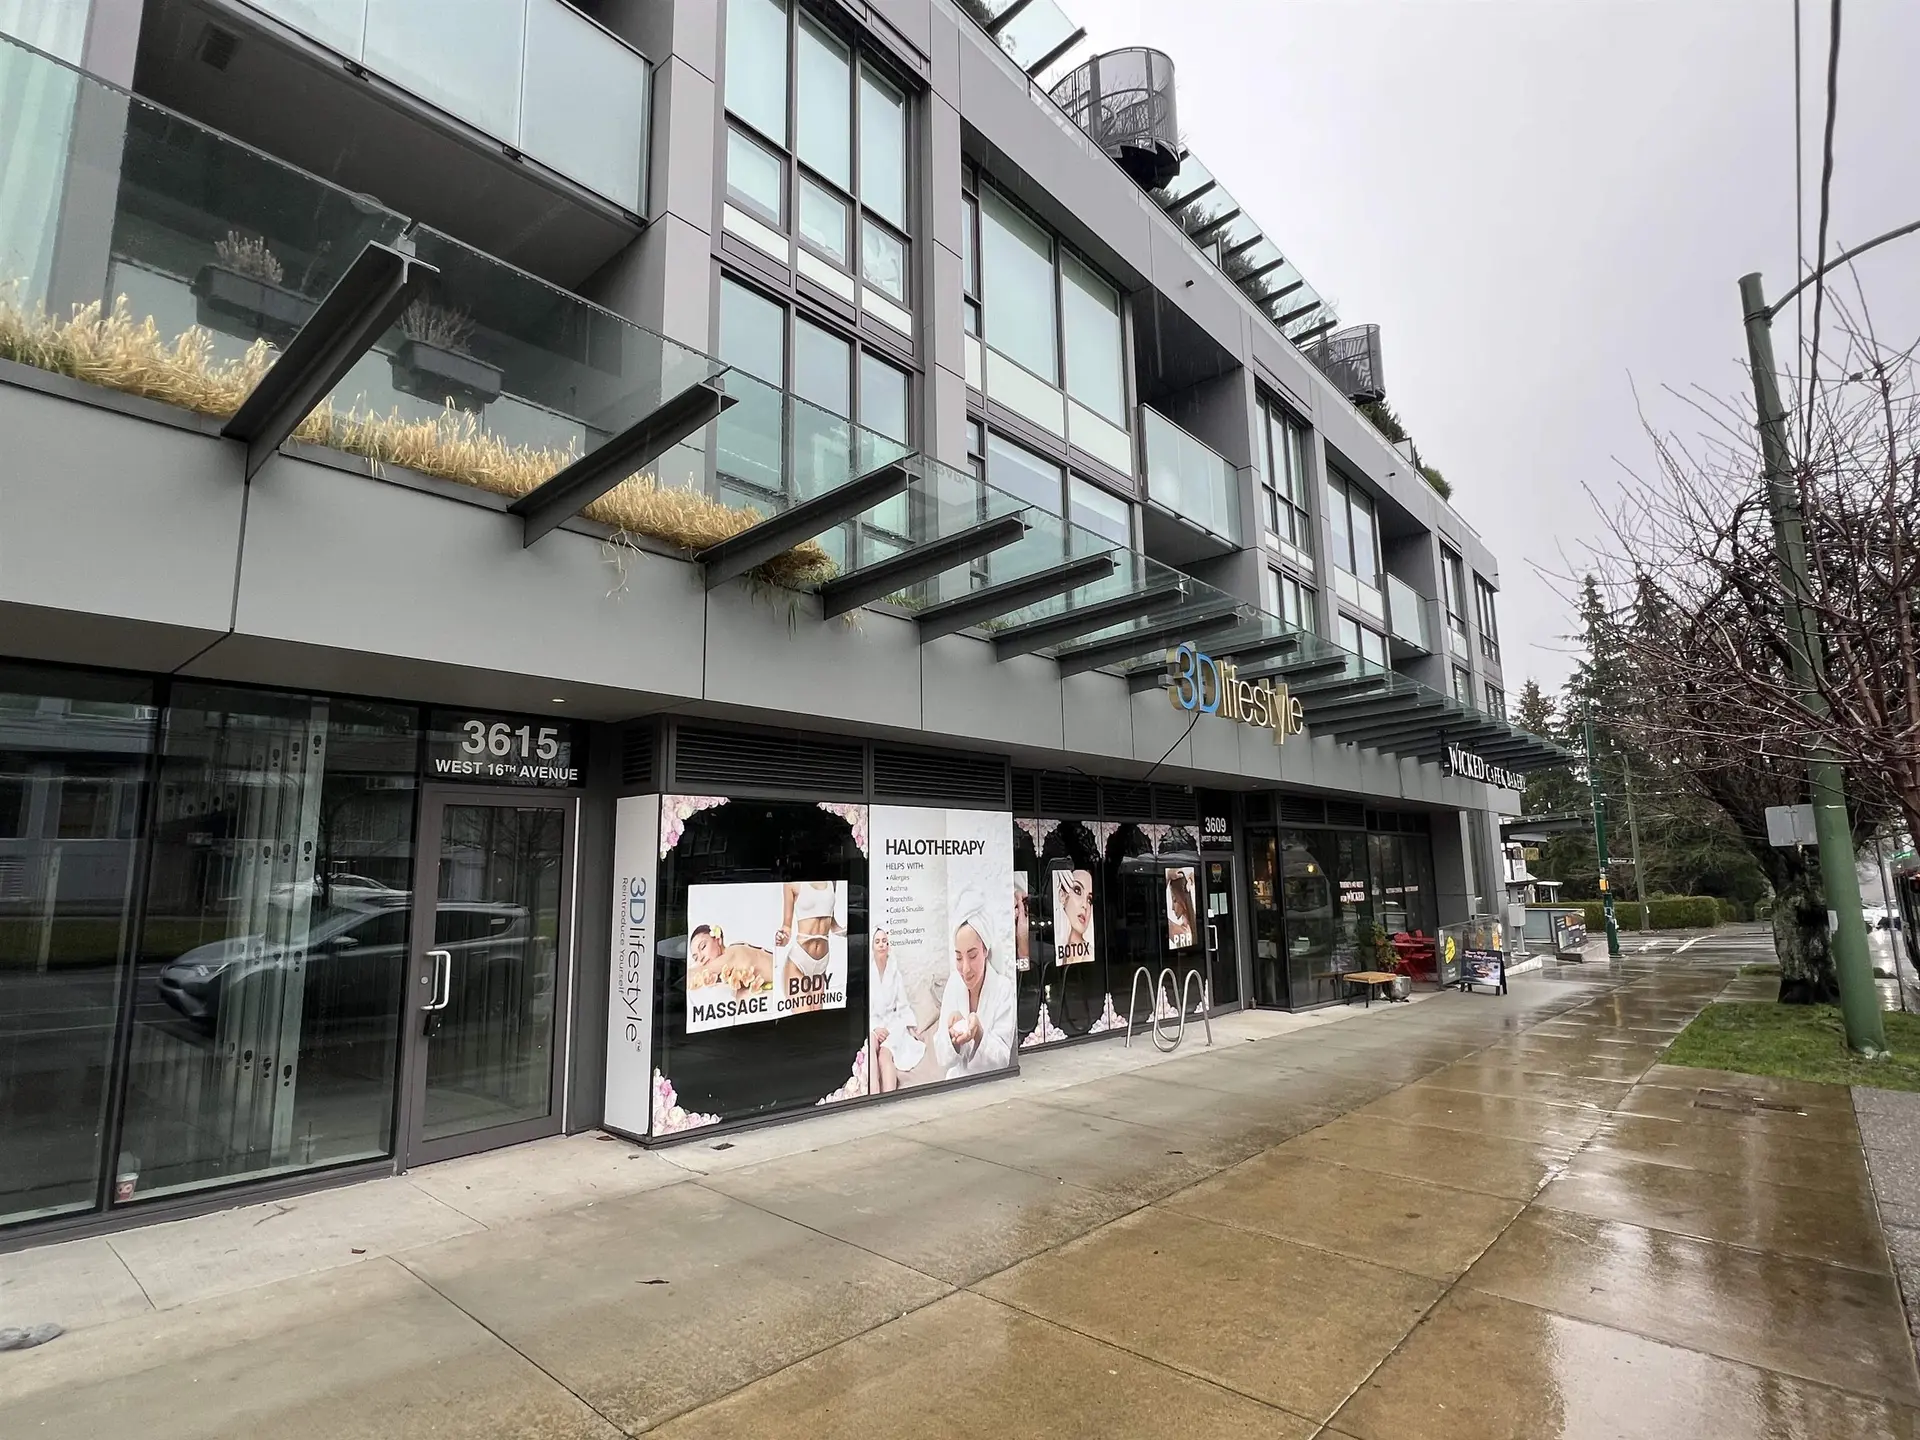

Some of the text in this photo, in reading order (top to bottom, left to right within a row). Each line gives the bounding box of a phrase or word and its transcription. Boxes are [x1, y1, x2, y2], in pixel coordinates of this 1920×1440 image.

[1167, 643, 1304, 745] 3Dlifestyle
[462, 720, 559, 760] 3615
[435, 759, 578, 780] WEST 16TH AVENUE
[1448, 742, 1485, 779] WICKED
[1205, 816, 1227, 833] 3609
[885, 838, 985, 856] HALOTHERAPY
[885, 862, 905, 870] HELPS
[618, 877, 629, 994] Reintroduce Yourself
[1058, 942, 1090, 959] BOTOX
[789, 972, 833, 996] BODY
[692, 996, 768, 1023] MASSAGE
[777, 991, 843, 1012] CONTOURING
